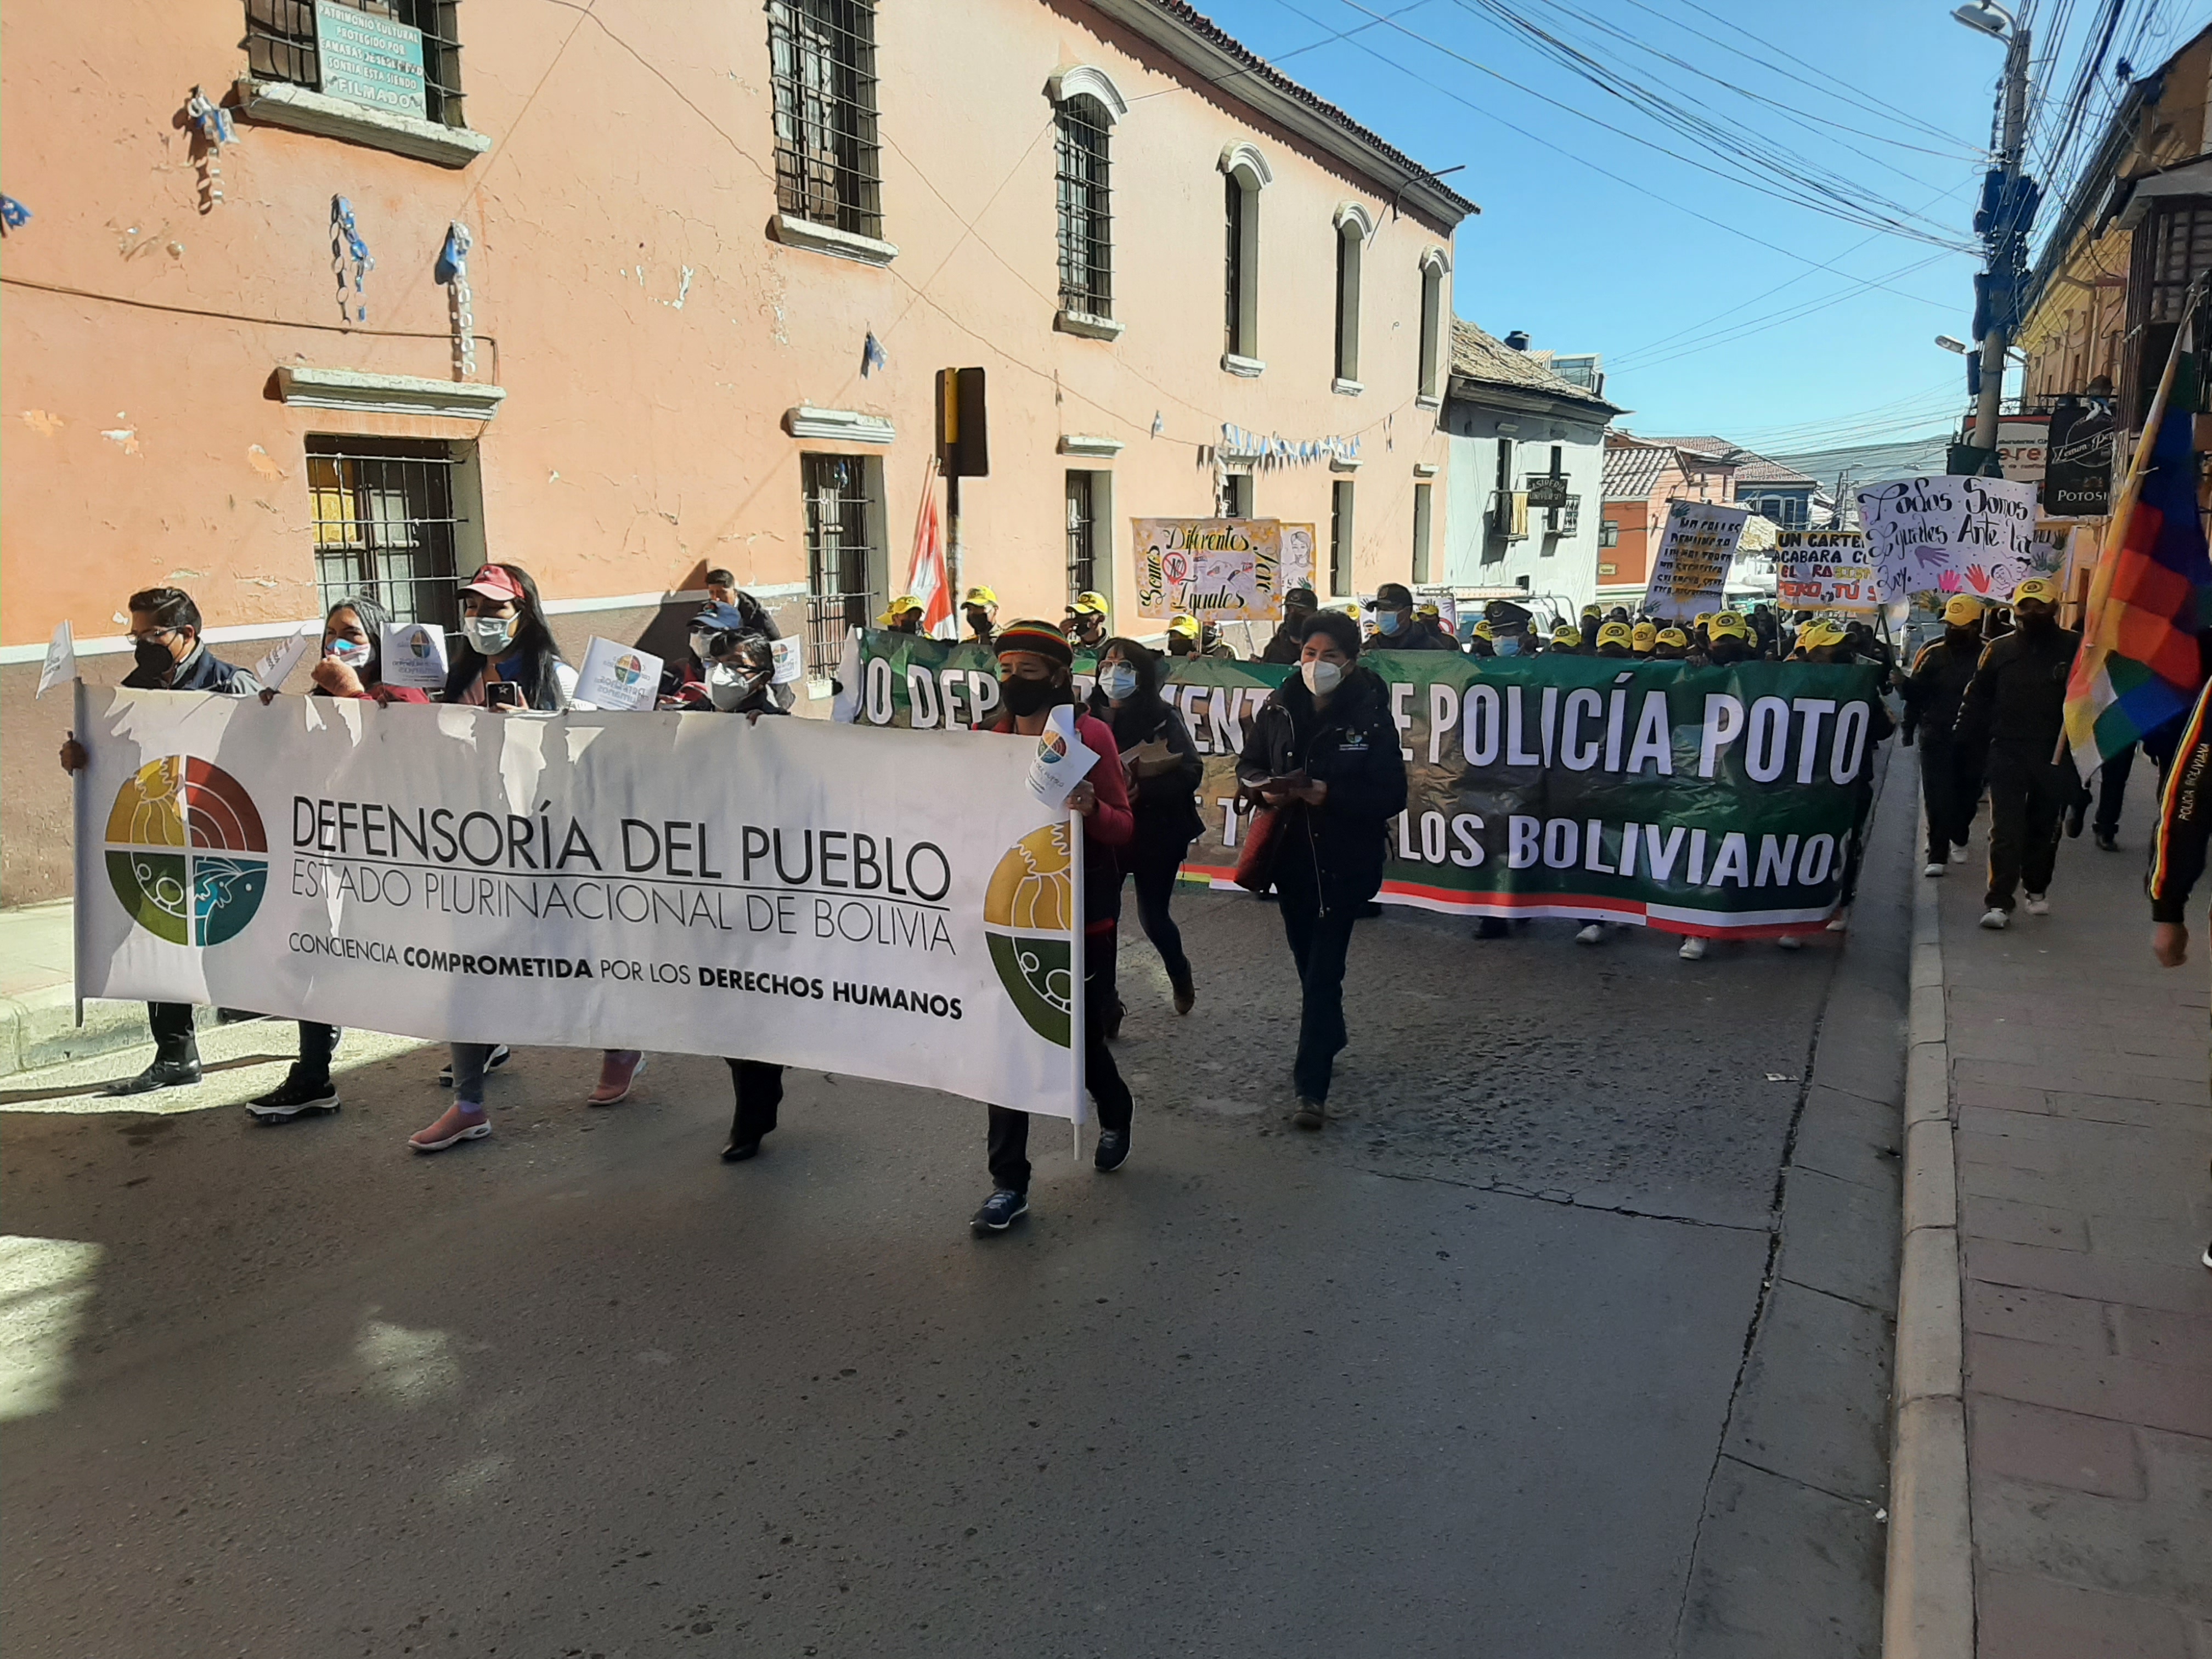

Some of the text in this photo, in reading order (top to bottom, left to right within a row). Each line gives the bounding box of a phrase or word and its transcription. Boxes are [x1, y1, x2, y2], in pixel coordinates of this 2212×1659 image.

[318, 4, 419, 43] PATRIMONIO CULTURAL
[336, 26, 407, 55] PROTEGIDO POR
[319, 38, 364, 59] CAMARAS
[329, 57, 417, 90] SONRIA ESTA SIENDO
[337, 77, 411, 108] FILMADO
[1857, 477, 2028, 525] Todos Somos
[1163, 523, 1250, 555] Diferentes
[1778, 533, 1801, 548] UN
[1957, 512, 2000, 550] Ante
[2006, 519, 2031, 554] la
[1139, 544, 1166, 607] Somos
[1772, 550, 1842, 563] ACABARA
[1781, 565, 1797, 578] EL
[1170, 575, 1245, 617] Iguales
[1832, 579, 1860, 600] TÚ
[1429, 672, 1673, 775] POLICÍA
[1698, 692, 1870, 785] POTO
[293, 795, 951, 901] DEFENSORÍA DEL PUEBLO
[1397, 808, 1485, 868] LOS
[292, 857, 956, 955] ESTADO PLURINACIONAL DE BOLIVIA
[289, 933, 963, 1020] CONCIENCIA COMPROMETIDA POR LOS DERECHOS HUMANOS
